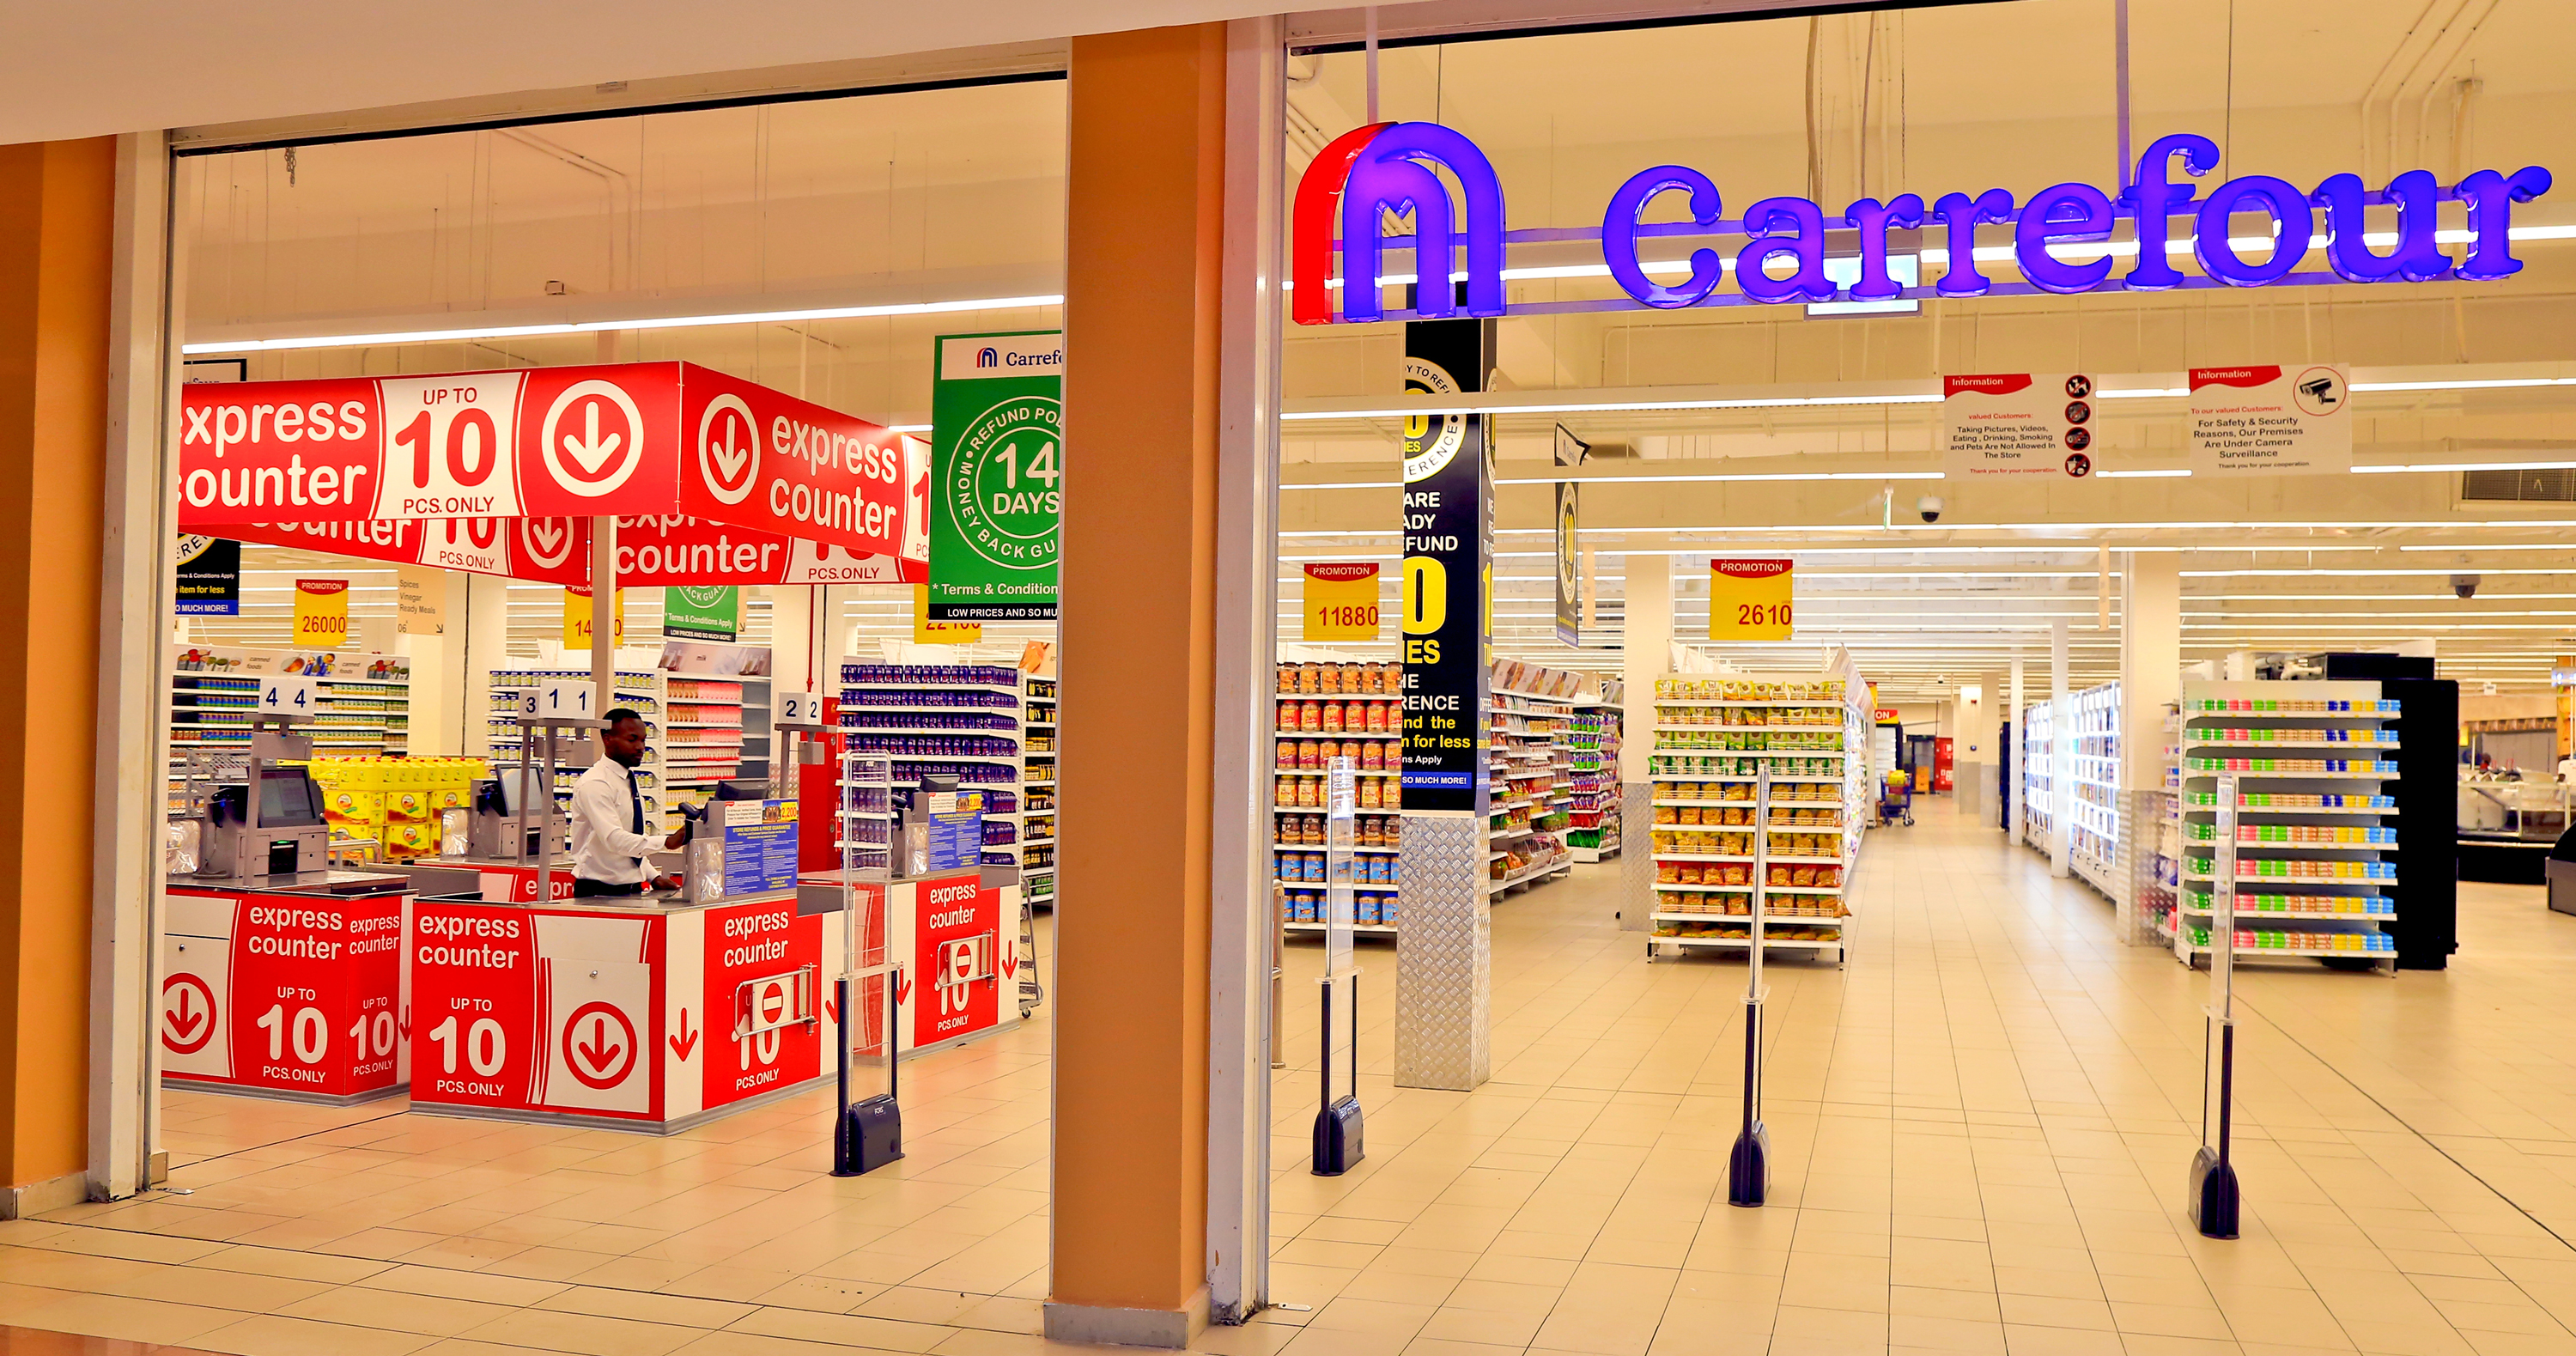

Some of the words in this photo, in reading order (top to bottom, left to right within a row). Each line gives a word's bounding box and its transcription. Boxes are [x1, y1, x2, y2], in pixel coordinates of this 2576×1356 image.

[1602, 133, 2552, 309] Carrefour
[1417, 366, 1430, 377] TO
[2197, 369, 2251, 379] Information
[423, 389, 448, 405] UP
[453, 387, 477, 403] TO
[180, 400, 367, 458] xpress
[970, 407, 1030, 450] REFUND
[2216, 418, 2246, 428] Safety
[2258, 417, 2299, 426] Security
[2193, 430, 2237, 439] Reasons,
[2259, 428, 2303, 436] Premises
[395, 408, 496, 489] 10
[772, 415, 897, 484] express
[2219, 450, 2278, 459] Surveillance
[995, 441, 1059, 489] 14
[179, 453, 367, 508] ounter
[957, 461, 981, 527] MONEY
[993, 491, 1060, 515] DAYS
[445, 496, 495, 513] ONLY
[770, 477, 897, 540] counter
[977, 528, 1024, 558] BACK
[616, 534, 780, 575] counter
[841, 568, 880, 580] ONLY
[1313, 567, 1370, 575] PROMOTION
[1721, 562, 1783, 572] PROMOTION
[399, 580, 419, 590] Spices
[942, 583, 981, 595] Terms
[984, 583, 993, 594] &
[399, 593, 422, 603] Vinegar
[399, 605, 417, 615] Ready
[419, 605, 435, 615] Meals
[947, 609, 969, 617] LOW
[969, 609, 1004, 617] PRICES
[1319, 605, 1378, 626] 11880
[1739, 604, 1792, 625] 2610
[302, 616, 345, 633] 26000
[668, 612, 683, 622] Terms
[690, 615, 718, 625] Conditions
[719, 618, 732, 629] Apply
[265, 687, 278, 707] 4
[294, 689, 306, 708] 4
[526, 696, 536, 713] 3
[549, 688, 558, 708] 1
[579, 690, 586, 711] 1
[786, 700, 797, 717] 2
[810, 701, 817, 718] 2
[1431, 715, 1455, 729] the
[1413, 734, 1436, 748] for
[1440, 734, 1471, 748] less
[1415, 756, 1442, 765] Apply
[930, 884, 976, 908] express
[250, 906, 343, 932] express
[349, 915, 400, 936] express
[725, 911, 789, 940] express
[929, 905, 975, 929] counter
[419, 915, 519, 941] express
[248, 934, 342, 960] counter
[349, 934, 399, 955] counter
[724, 937, 788, 968] counter
[418, 943, 519, 969] counter
[277, 986, 295, 998] UP
[298, 988, 316, 1000] TO
[362, 999, 374, 1009] UP
[376, 996, 387, 1006] TO
[451, 997, 470, 1010] UP
[473, 999, 492, 1012] TO
[257, 1004, 328, 1064] 10
[349, 1011, 395, 1061] 10
[429, 1015, 506, 1077] 10
[292, 1068, 325, 1083] ONLY
[468, 1082, 504, 1097] ONLY
